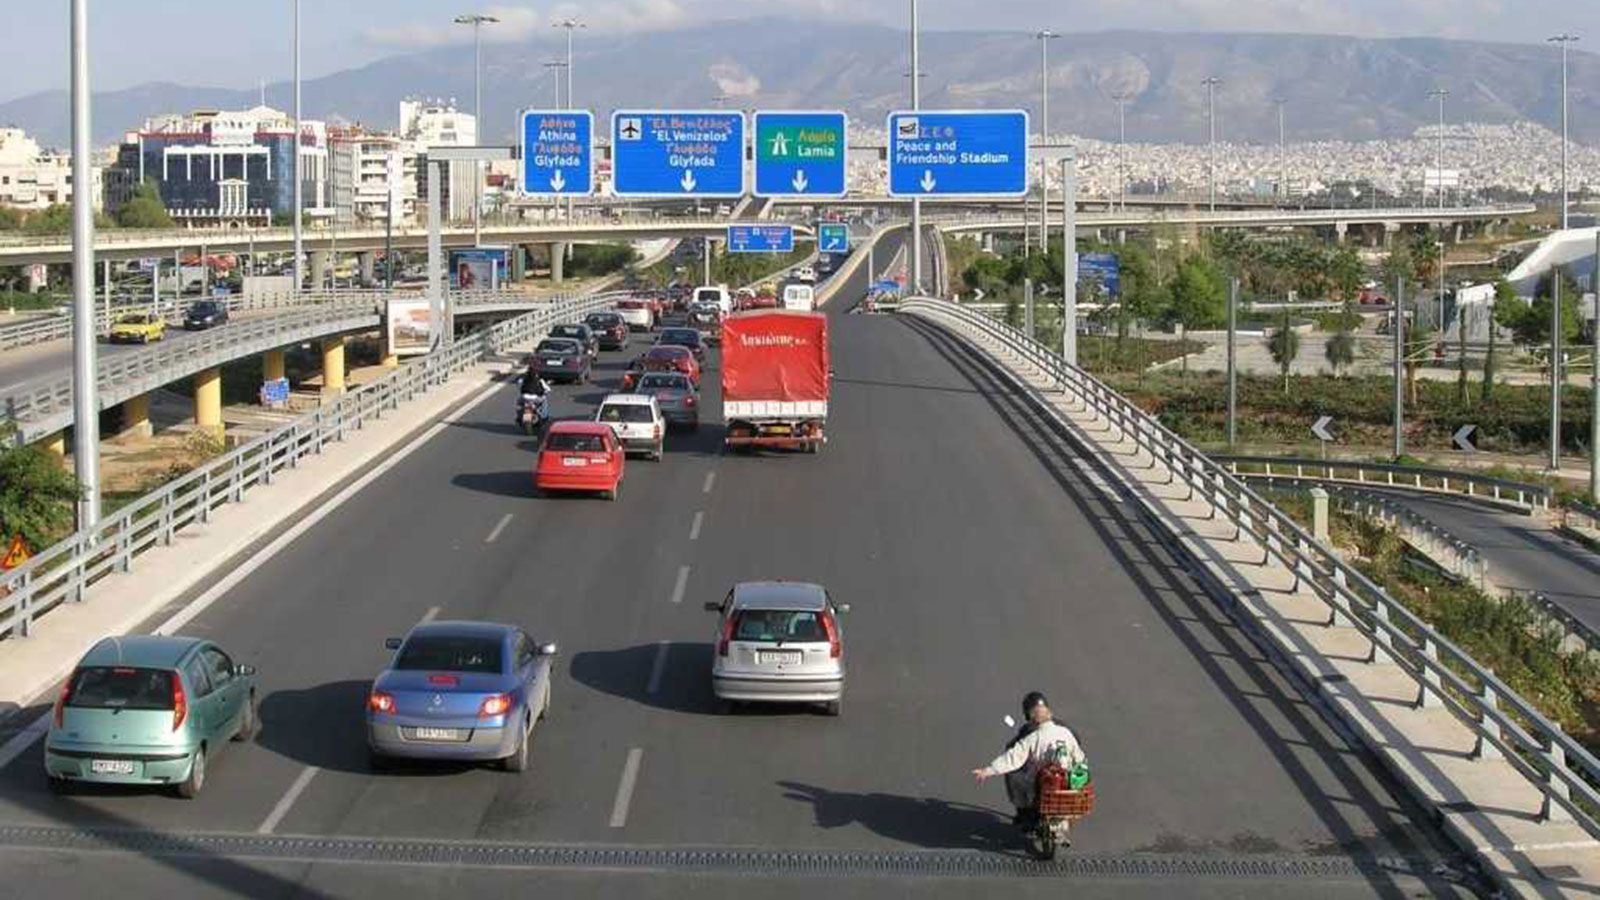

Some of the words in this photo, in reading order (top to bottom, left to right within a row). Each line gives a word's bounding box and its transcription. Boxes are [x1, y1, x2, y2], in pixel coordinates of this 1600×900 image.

[539, 131, 576, 142] Athina
[798, 145, 836, 158] Lamia
[896, 140, 931, 152] Peace
[935, 140, 957, 152] and
[535, 155, 581, 168] Glyfada
[669, 154, 716, 168] Glyfada
[896, 153, 957, 165] Friendship
[960, 152, 1009, 164] Stadium
